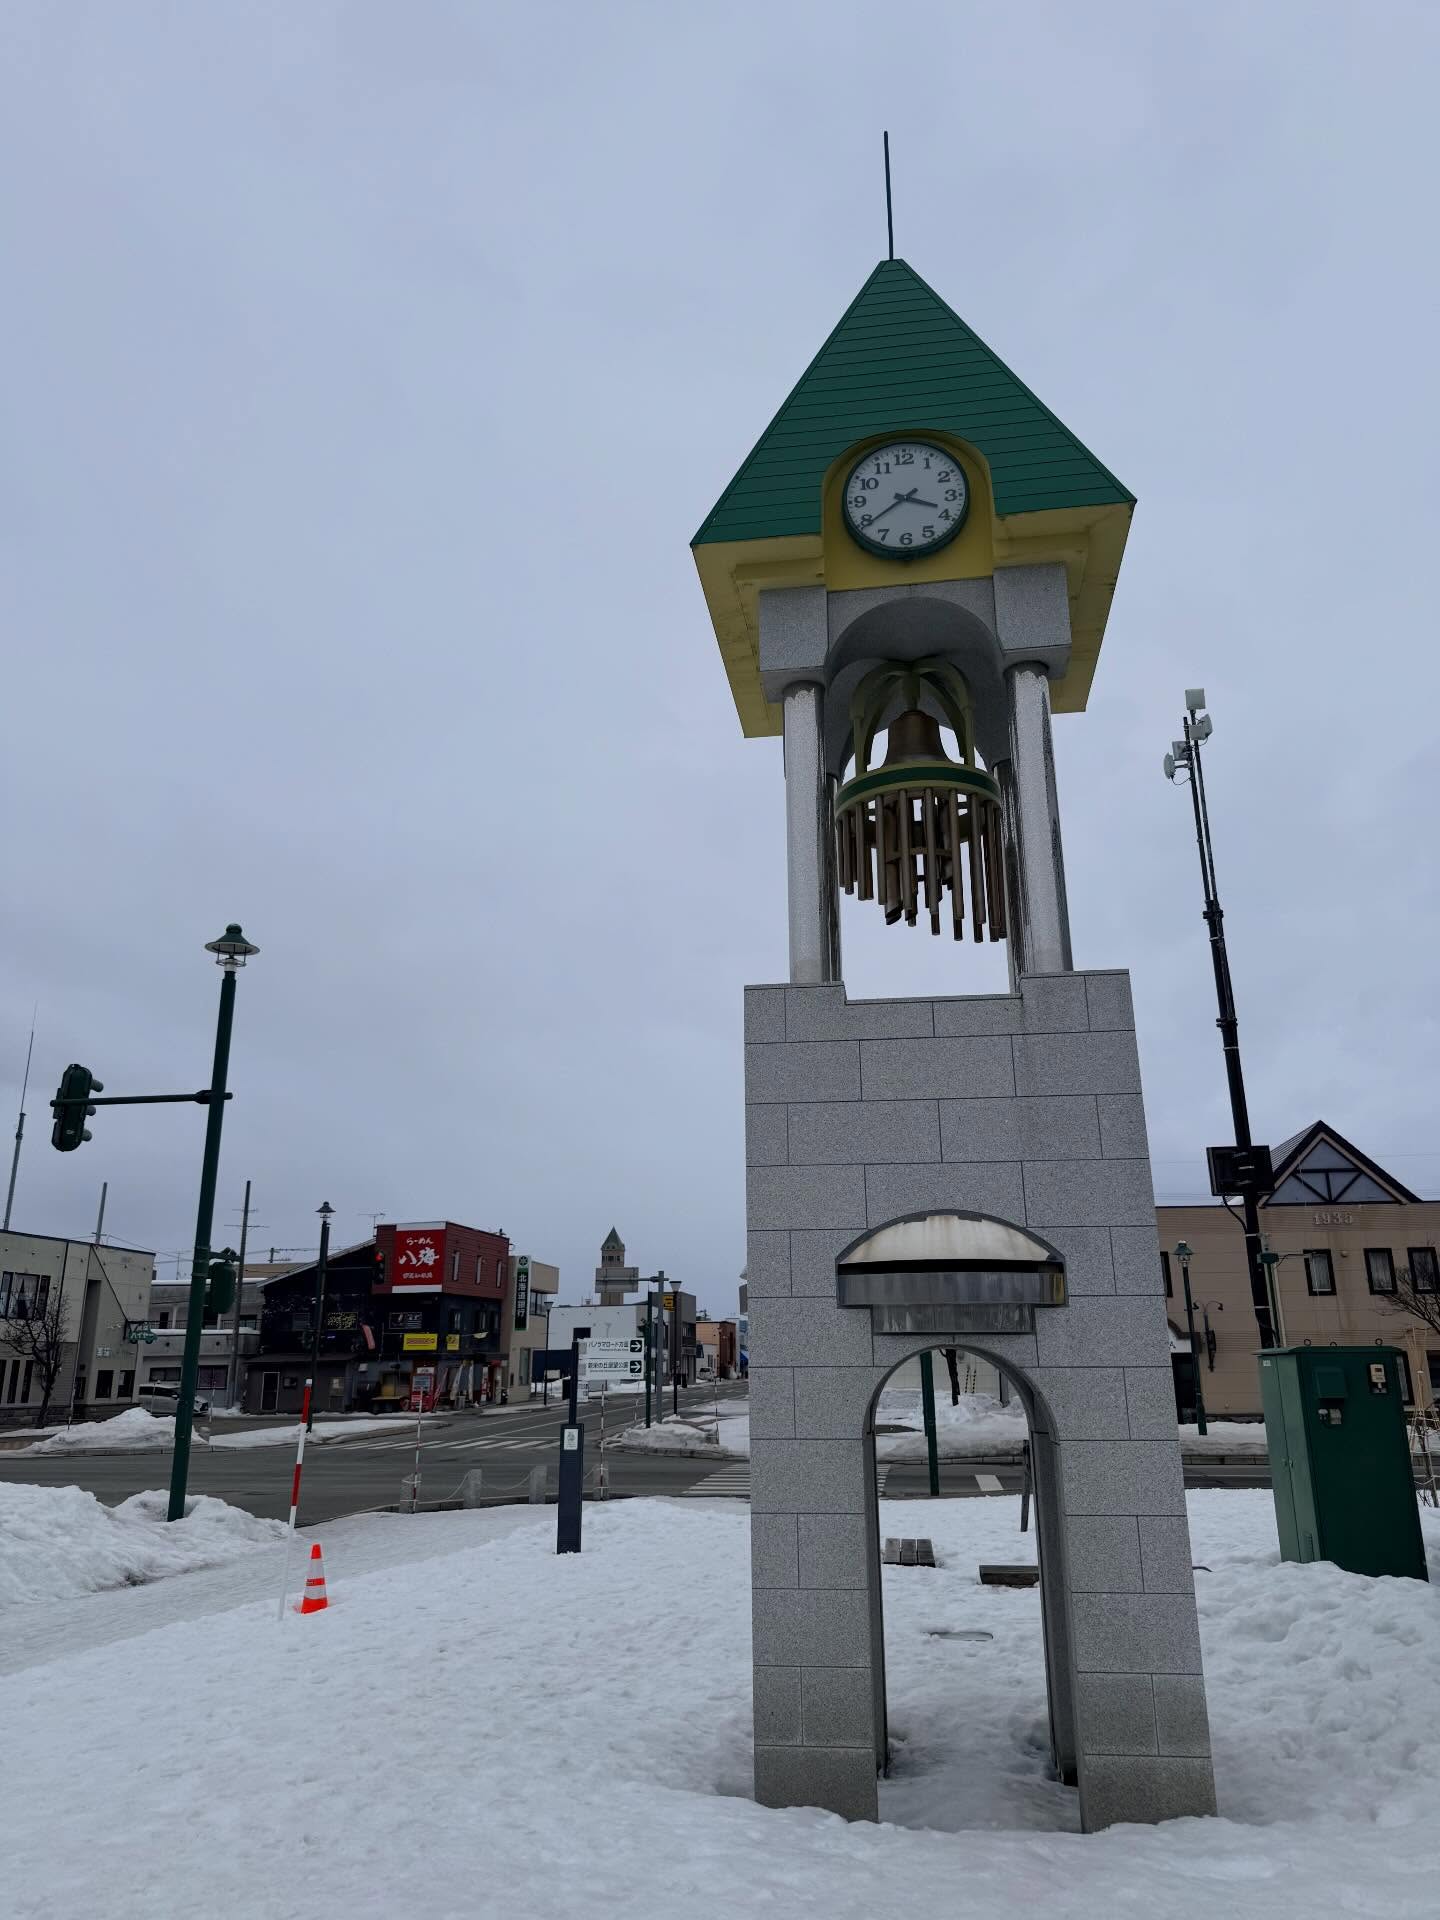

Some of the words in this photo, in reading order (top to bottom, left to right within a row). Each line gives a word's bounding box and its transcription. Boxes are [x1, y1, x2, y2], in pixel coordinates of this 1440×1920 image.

[894, 453, 914, 465] 12
[924, 457, 931, 469] 1
[874, 462, 891, 474] 11
[938, 470, 951, 483] 2
[860, 477, 879, 490] 10
[854, 495, 866, 508] 9
[944, 489, 958, 502] 3
[861, 514, 873, 527] 8
[938, 508, 952, 520] 4
[877, 528, 890, 541] 7
[922, 525, 935, 538] 5
[899, 533, 913, 545] 6
[406, 1237, 434, 1246] らーめん
[517, 1273, 528, 1318] 北海道銀行
